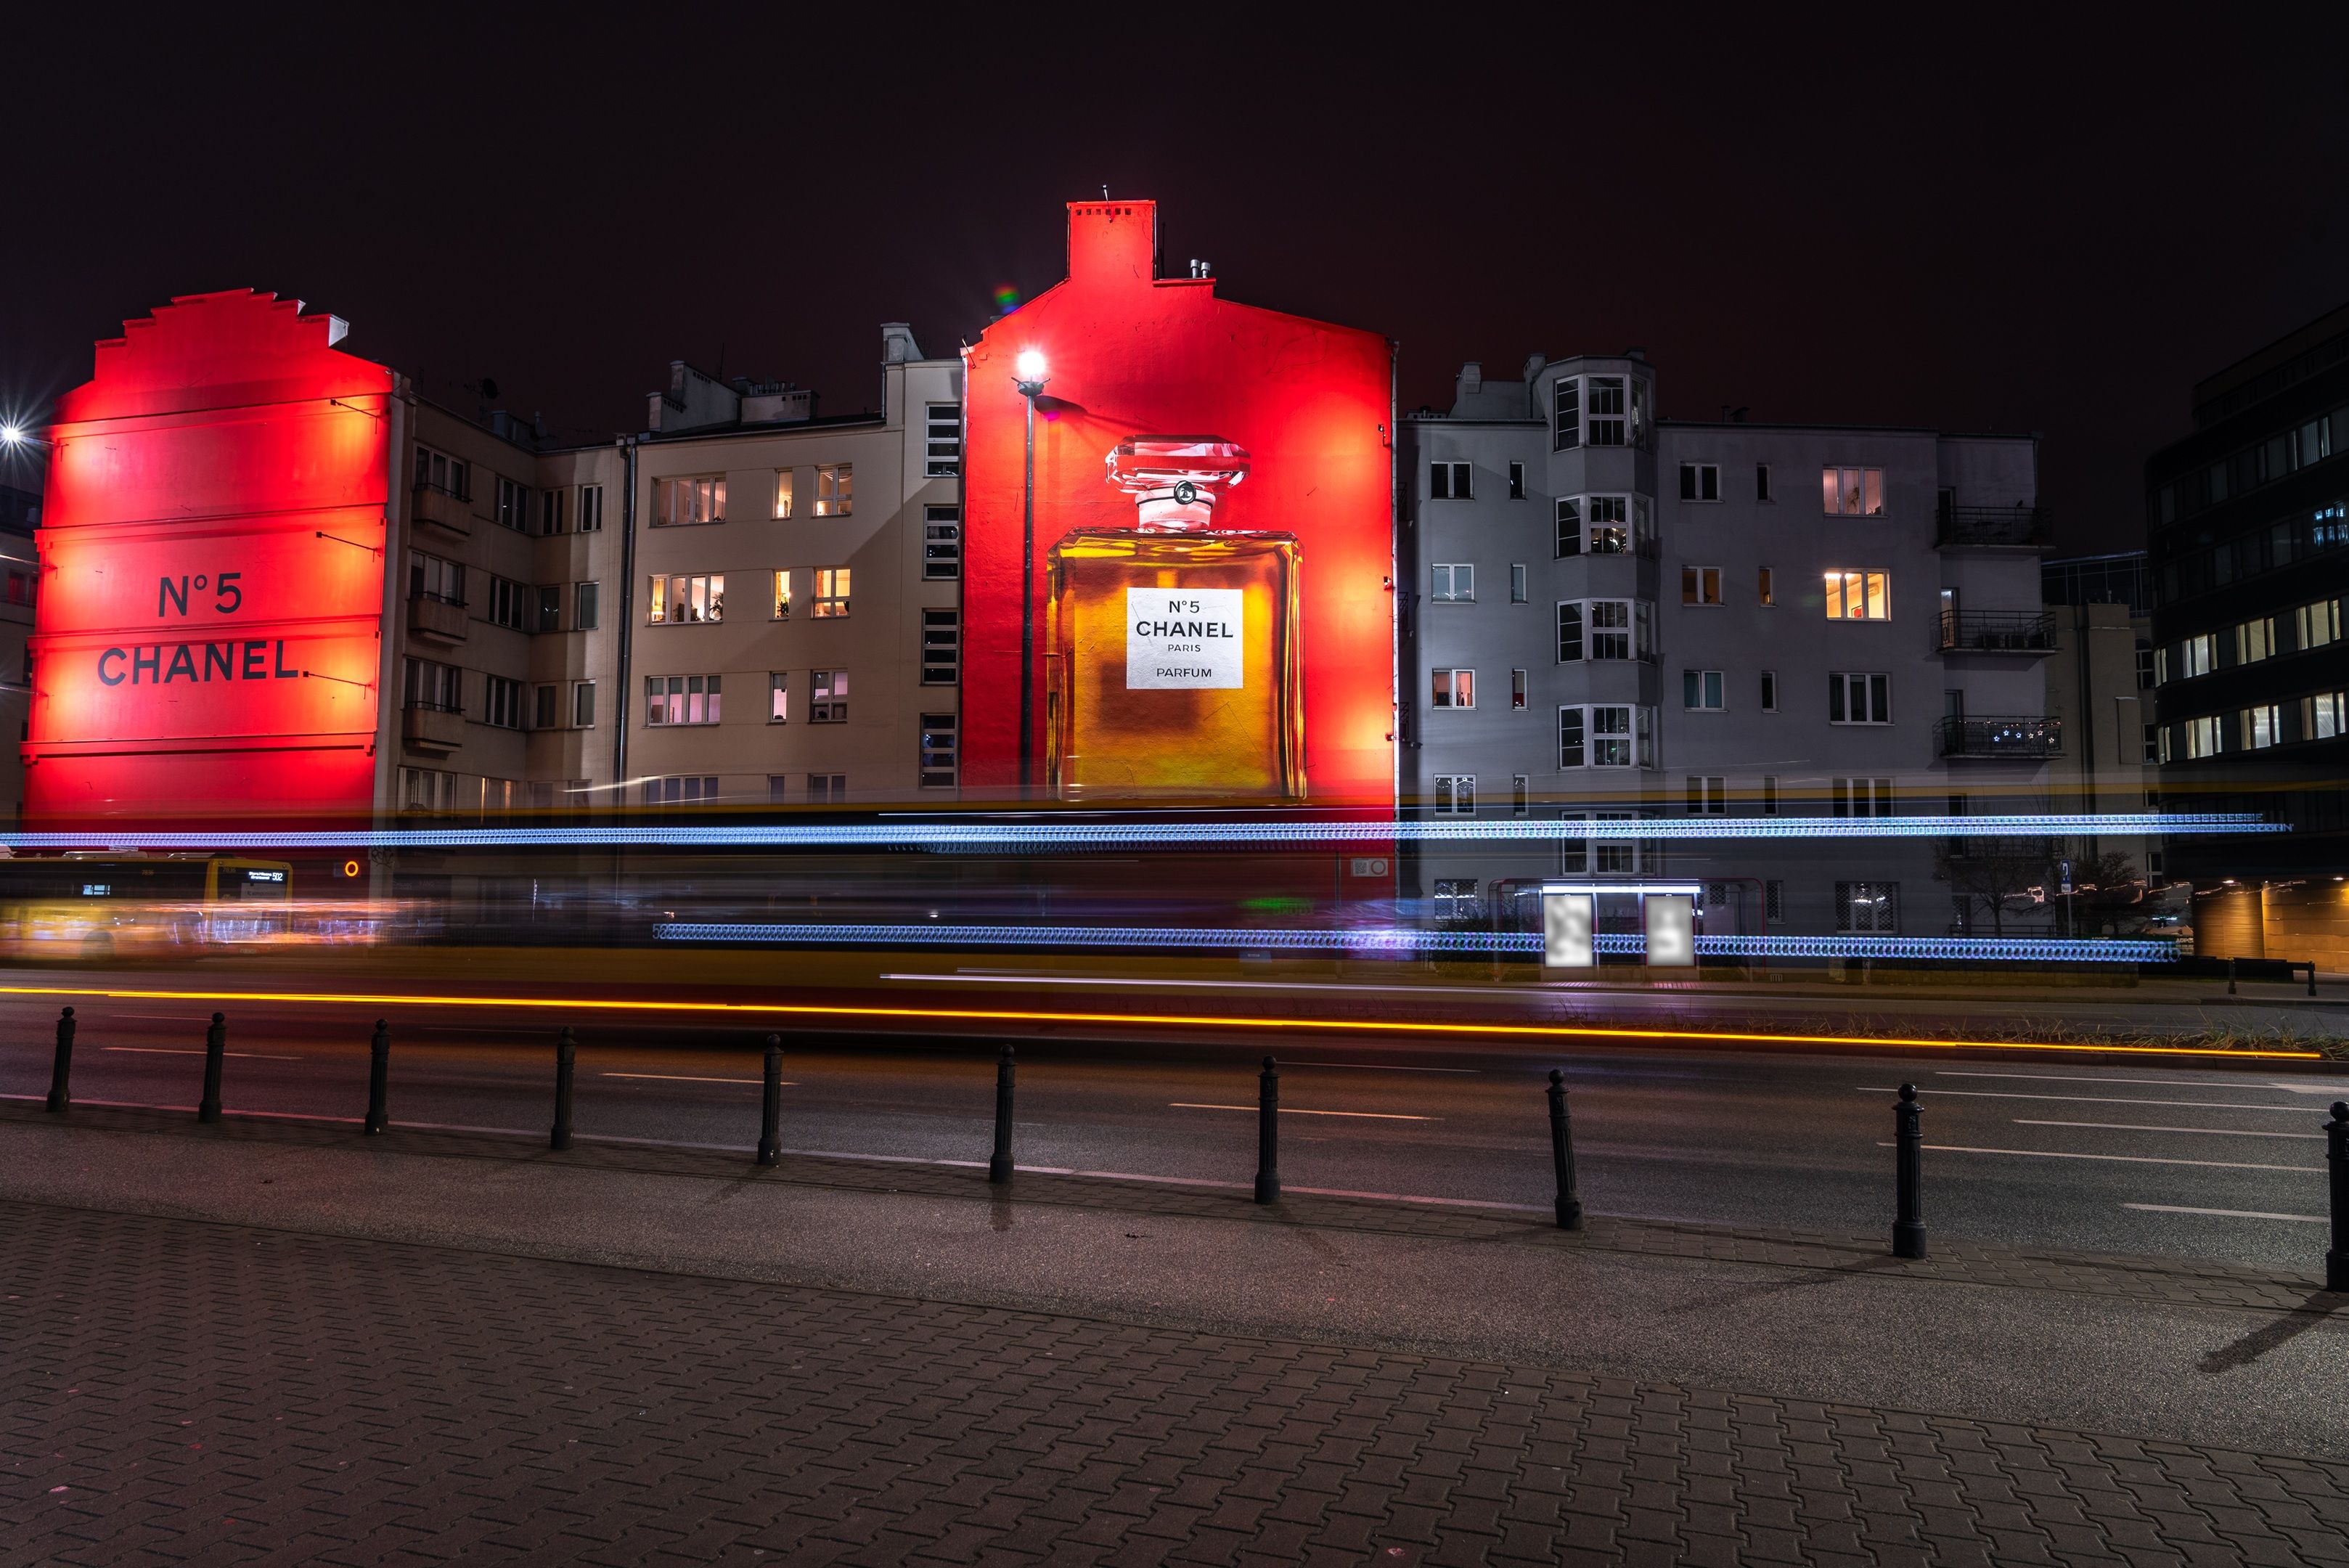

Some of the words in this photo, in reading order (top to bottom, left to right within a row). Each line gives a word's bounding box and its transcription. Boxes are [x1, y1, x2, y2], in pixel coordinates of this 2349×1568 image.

[158, 572, 242, 617] N°5
[1169, 600, 1200, 613] N°5
[1136, 621, 1233, 638] CHANEL
[1167, 644, 1201, 653] PARIS
[97, 640, 298, 686] CHANEL
[1156, 668, 1212, 678] PARFUM
[272, 873, 283, 881] 502
